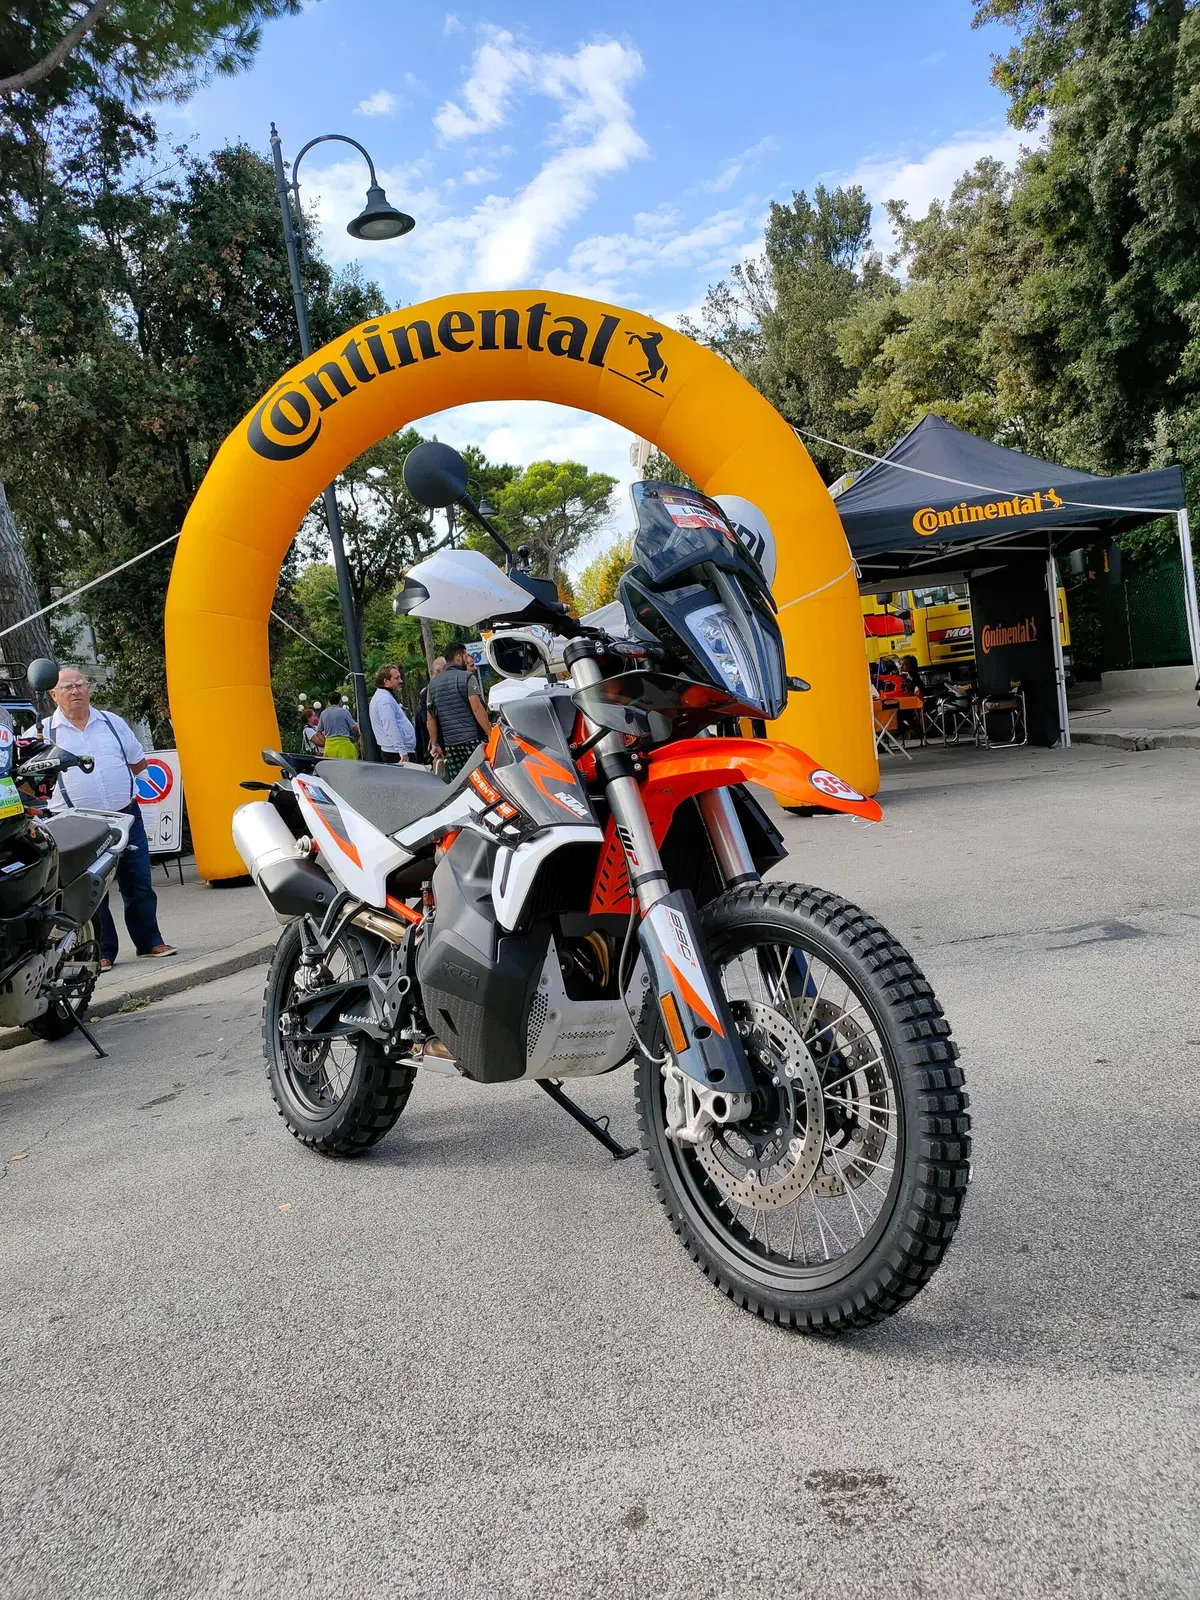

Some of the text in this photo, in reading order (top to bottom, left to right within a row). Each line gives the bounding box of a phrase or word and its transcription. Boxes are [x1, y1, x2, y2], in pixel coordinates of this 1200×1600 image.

[247, 302, 621, 461] Continental
[912, 492, 1044, 536] Continental
[944, 627, 973, 639] MO
[981, 618, 1030, 654] Continental
[554, 792, 589, 817] KTM
[95, 834, 113, 857] HONDA
[669, 911, 692, 961] 890
